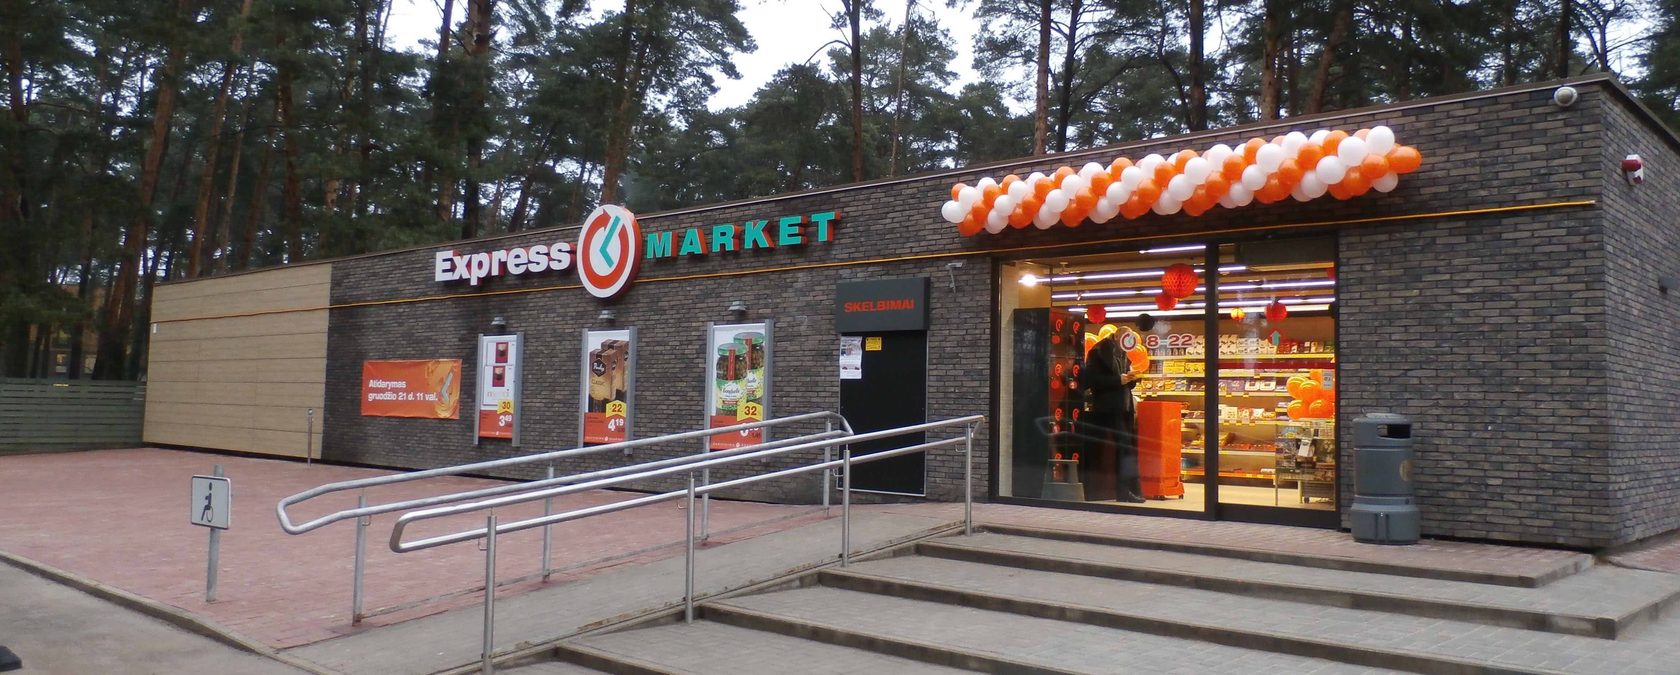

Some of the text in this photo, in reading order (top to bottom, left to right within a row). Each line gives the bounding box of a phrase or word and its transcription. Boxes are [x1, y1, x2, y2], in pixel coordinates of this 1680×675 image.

[646, 211, 837, 260] MARKET
[435, 244, 572, 285] Express
[844, 299, 915, 312] SKELBIMAI
[368, 379, 406, 390] Atidarymas
[368, 391, 439, 402] gruodžio 21 d. 11 val.
[502, 402, 511, 410] 30
[612, 403, 623, 413] 22
[744, 405, 757, 416] 32
